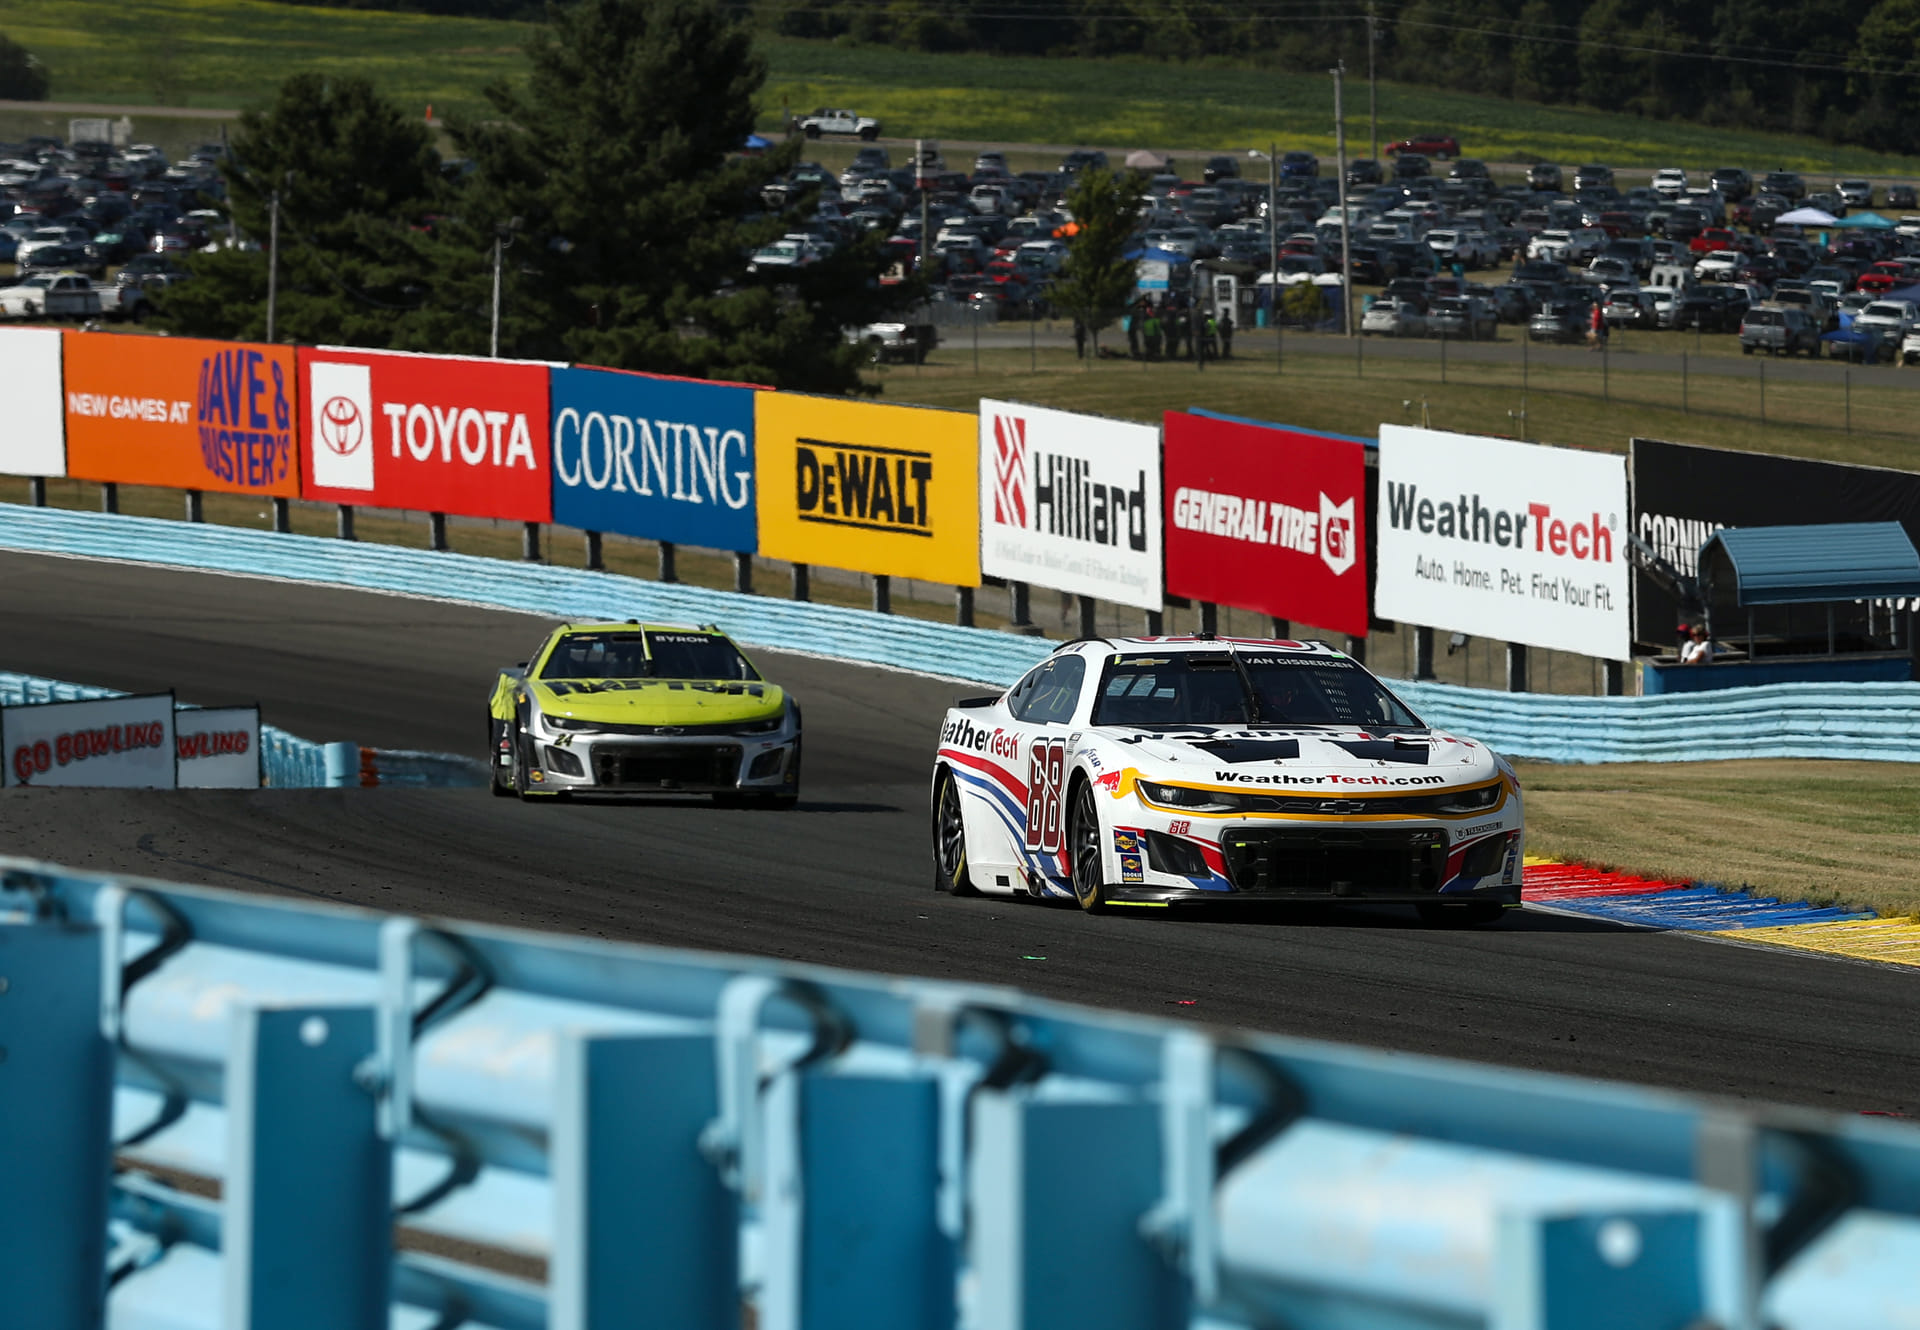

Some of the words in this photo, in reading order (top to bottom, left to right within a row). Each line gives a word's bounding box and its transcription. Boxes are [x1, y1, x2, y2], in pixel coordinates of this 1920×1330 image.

[68, 391, 108, 417] NEW
[109, 397, 167, 422] GAMES
[168, 401, 191, 424] AT
[382, 402, 537, 470] TOYOTA
[554, 407, 750, 509] CORNING
[1035, 451, 1147, 552] Hilliard
[1173, 486, 1269, 544] GENERAL
[1269, 502, 1319, 555] TIRE
[1415, 554, 1447, 582] Auto.
[1453, 560, 1494, 590] Home.
[1501, 568, 1525, 594] Pet.
[1532, 573, 1559, 601] Find
[1562, 578, 1591, 607] Your
[1595, 583, 1614, 611] Fit.
[655, 635, 709, 643] BYRON
[1277, 658, 1354, 669] GISBERGEN
[14, 744, 51, 780] GO
[55, 721, 164, 767] BOWLING
[554, 734, 574, 747] 24
[1025, 737, 1066, 856] 88
[1215, 771, 1445, 786] WeatherTech.com
[1168, 820, 1191, 835] 88
